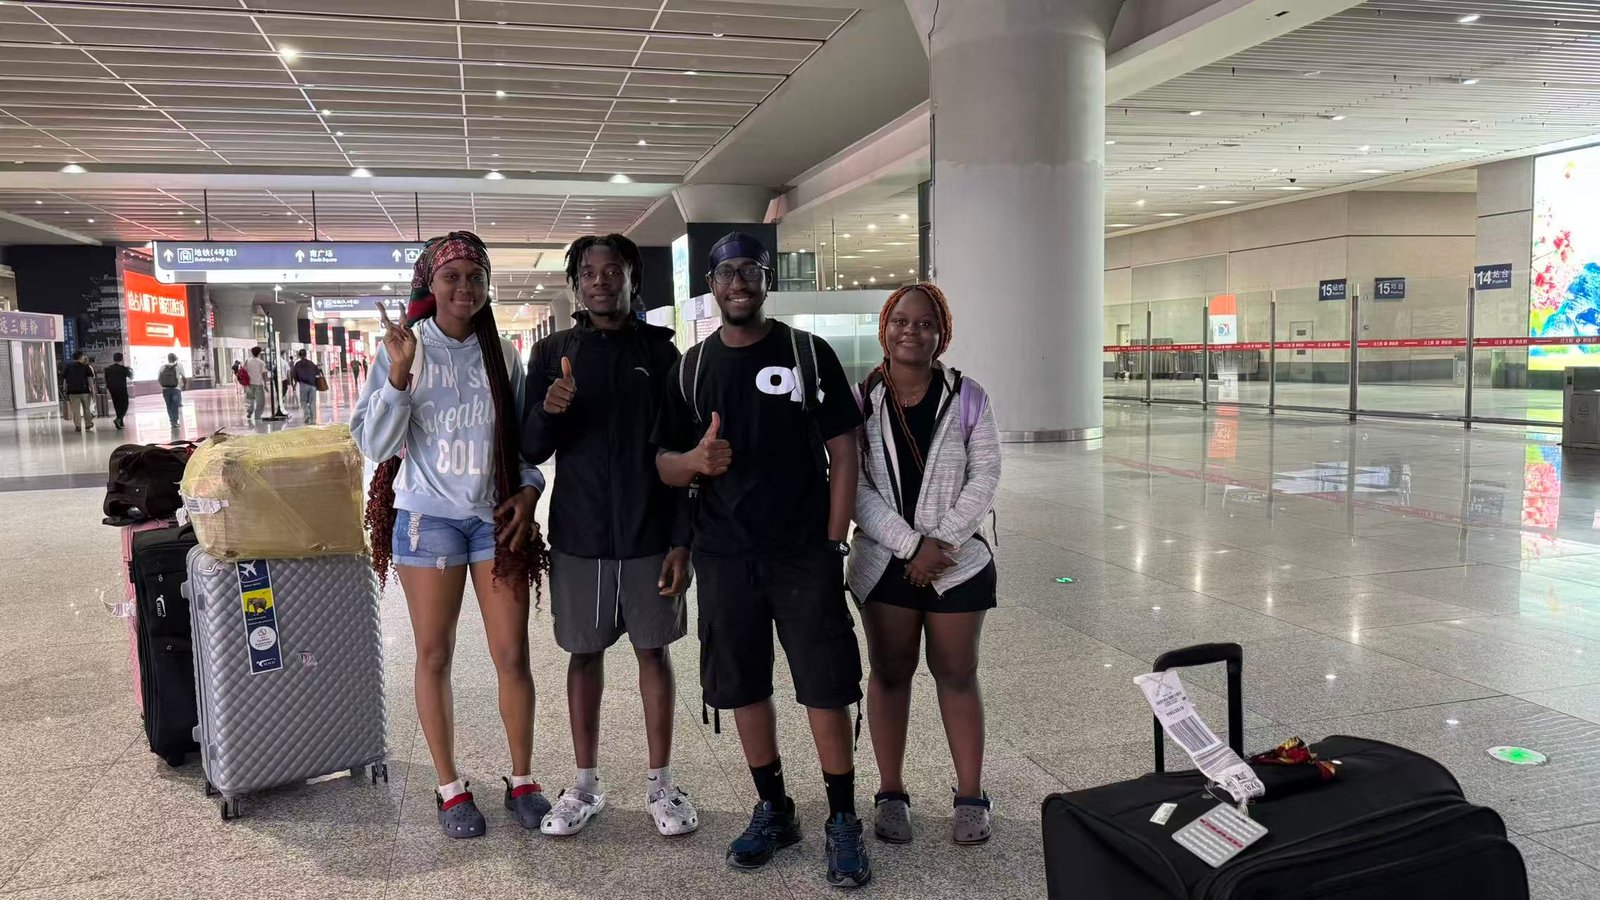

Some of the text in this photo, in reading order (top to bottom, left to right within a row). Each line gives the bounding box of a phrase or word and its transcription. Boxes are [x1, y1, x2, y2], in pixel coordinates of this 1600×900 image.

[194, 248, 237, 257] 地铁(4号线)
[309, 249, 333, 258] 南广场
[1477, 269, 1509, 285] 14 站台
[1321, 284, 1332, 296] 15
[1377, 283, 1390, 294] 15
[427, 363, 459, 388] I'M
[417, 394, 495, 446] Freaki
